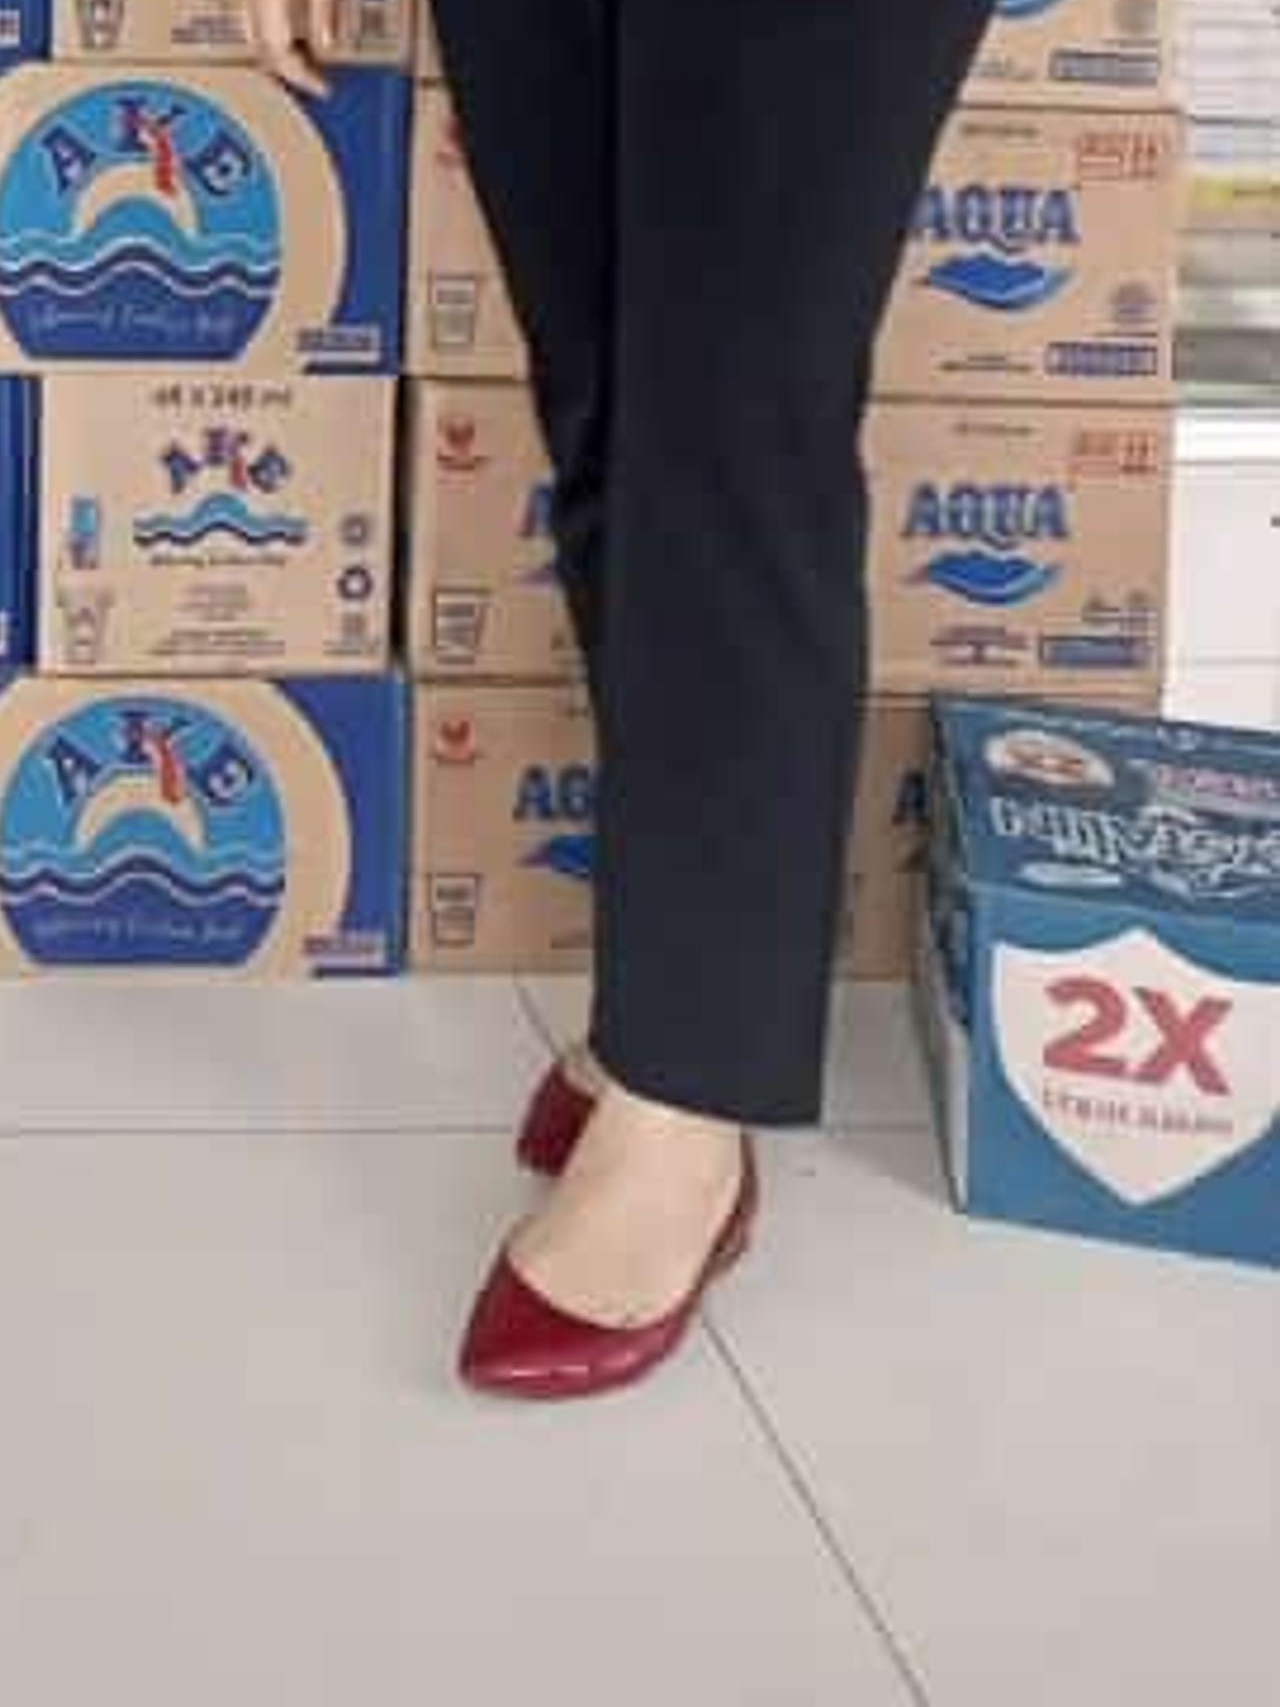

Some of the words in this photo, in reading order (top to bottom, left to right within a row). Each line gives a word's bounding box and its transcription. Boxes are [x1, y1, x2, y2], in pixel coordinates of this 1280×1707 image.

[44, 96, 253, 199] AKE
[901, 482, 1072, 549] AQUA
[46, 709, 254, 809] AKE
[1043, 974, 1232, 1096] 2X
